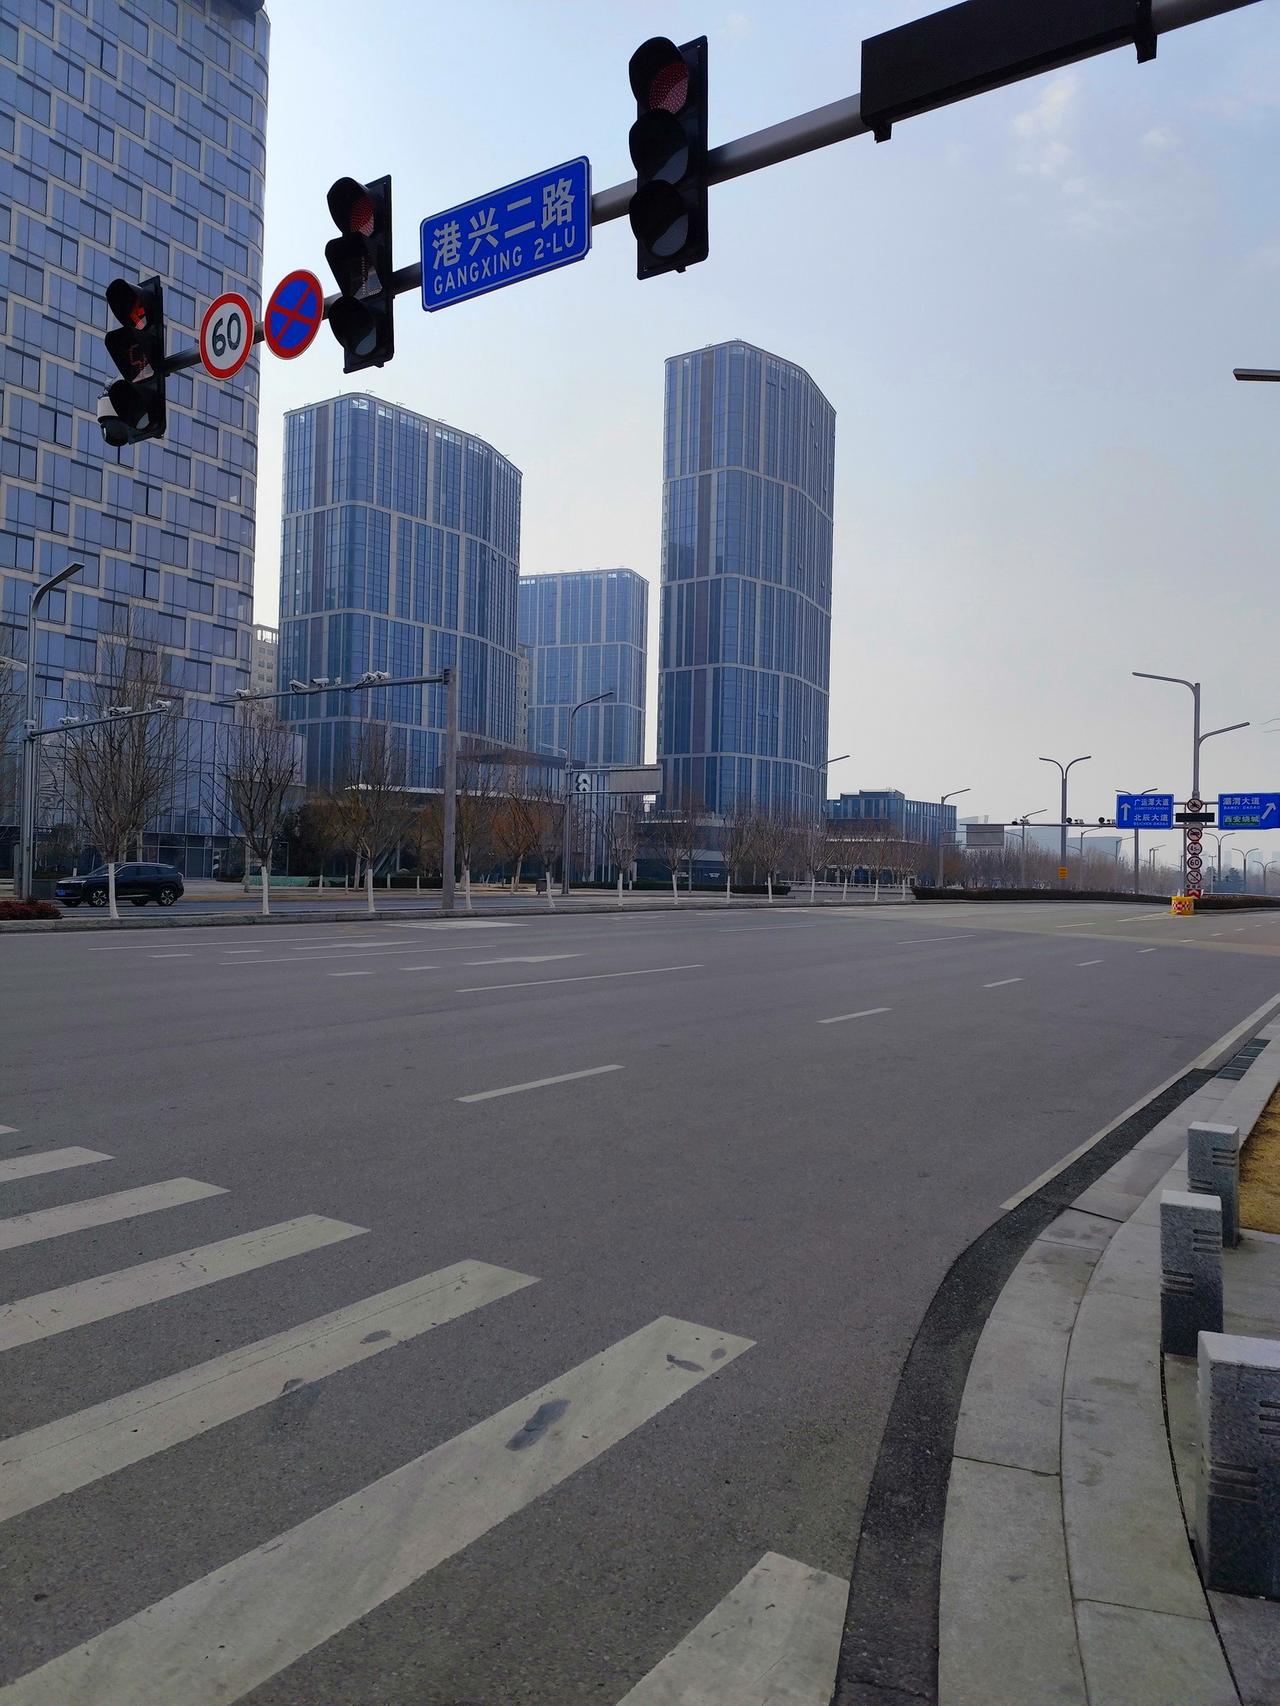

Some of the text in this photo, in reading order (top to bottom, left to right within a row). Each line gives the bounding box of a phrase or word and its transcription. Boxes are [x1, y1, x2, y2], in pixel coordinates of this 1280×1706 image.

[432, 178, 575, 270] 港兴二路
[433, 246, 522, 295] GANGXING
[212, 312, 241, 357] 60
